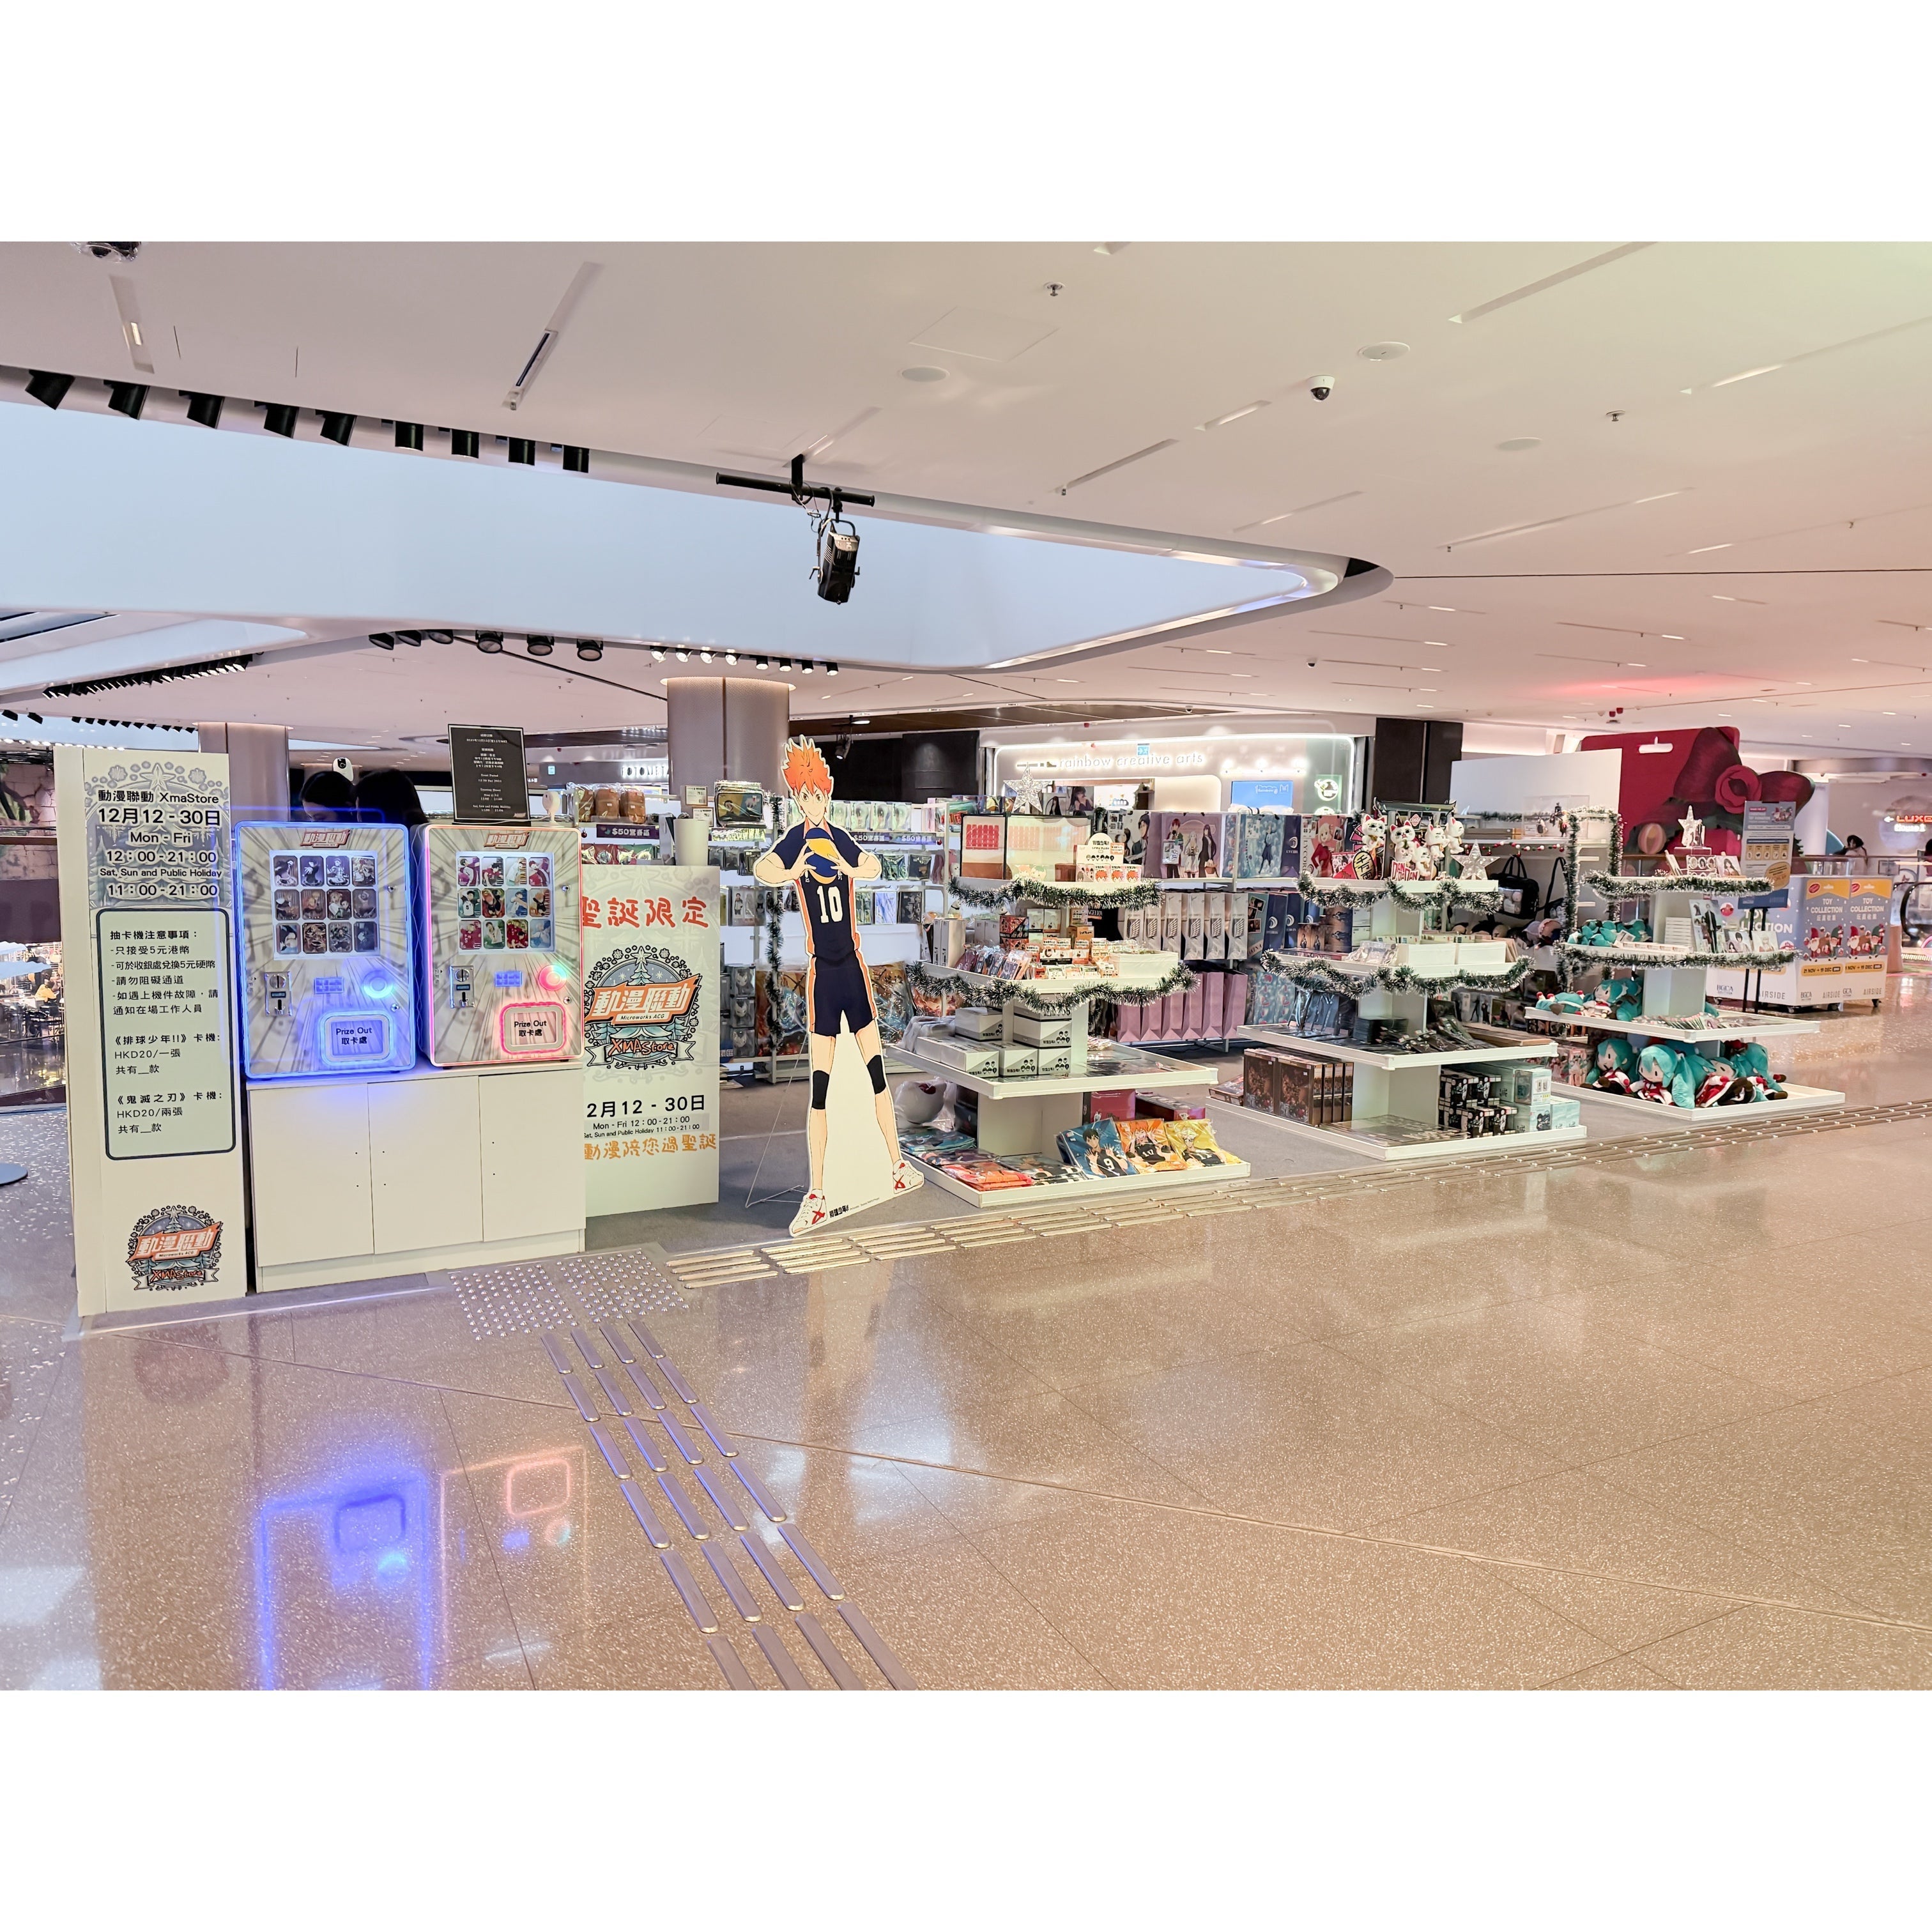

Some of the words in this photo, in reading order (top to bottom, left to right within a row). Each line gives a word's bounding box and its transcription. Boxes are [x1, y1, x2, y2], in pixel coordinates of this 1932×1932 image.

[1059, 755, 1111, 767] rainbow
[1117, 753, 1170, 766] creative
[1176, 753, 1203, 764] arts
[98, 790, 154, 802] 動漫聯動
[159, 792, 219, 804] XmaStore
[130, 832, 159, 843] Mon
[173, 832, 191, 843] Fri
[100, 868, 118, 877] Sat,
[160, 869, 187, 877] Public
[190, 870, 222, 878] Holiday
[817, 885, 843, 923] 10
[583, 896, 709, 928] 聖誕限定
[592, 983, 691, 1016] 動漫聯動
[1759, 991, 1786, 1000] IRSIDE
[113, 1005, 202, 1015] 通知在場工作人員
[114, 1048, 180, 1059] HKD20/一張
[665, 1095, 704, 1112] 30日
[117, 1108, 183, 1119] HKD20/兩張
[1104, 1158, 1115, 1170] 9
